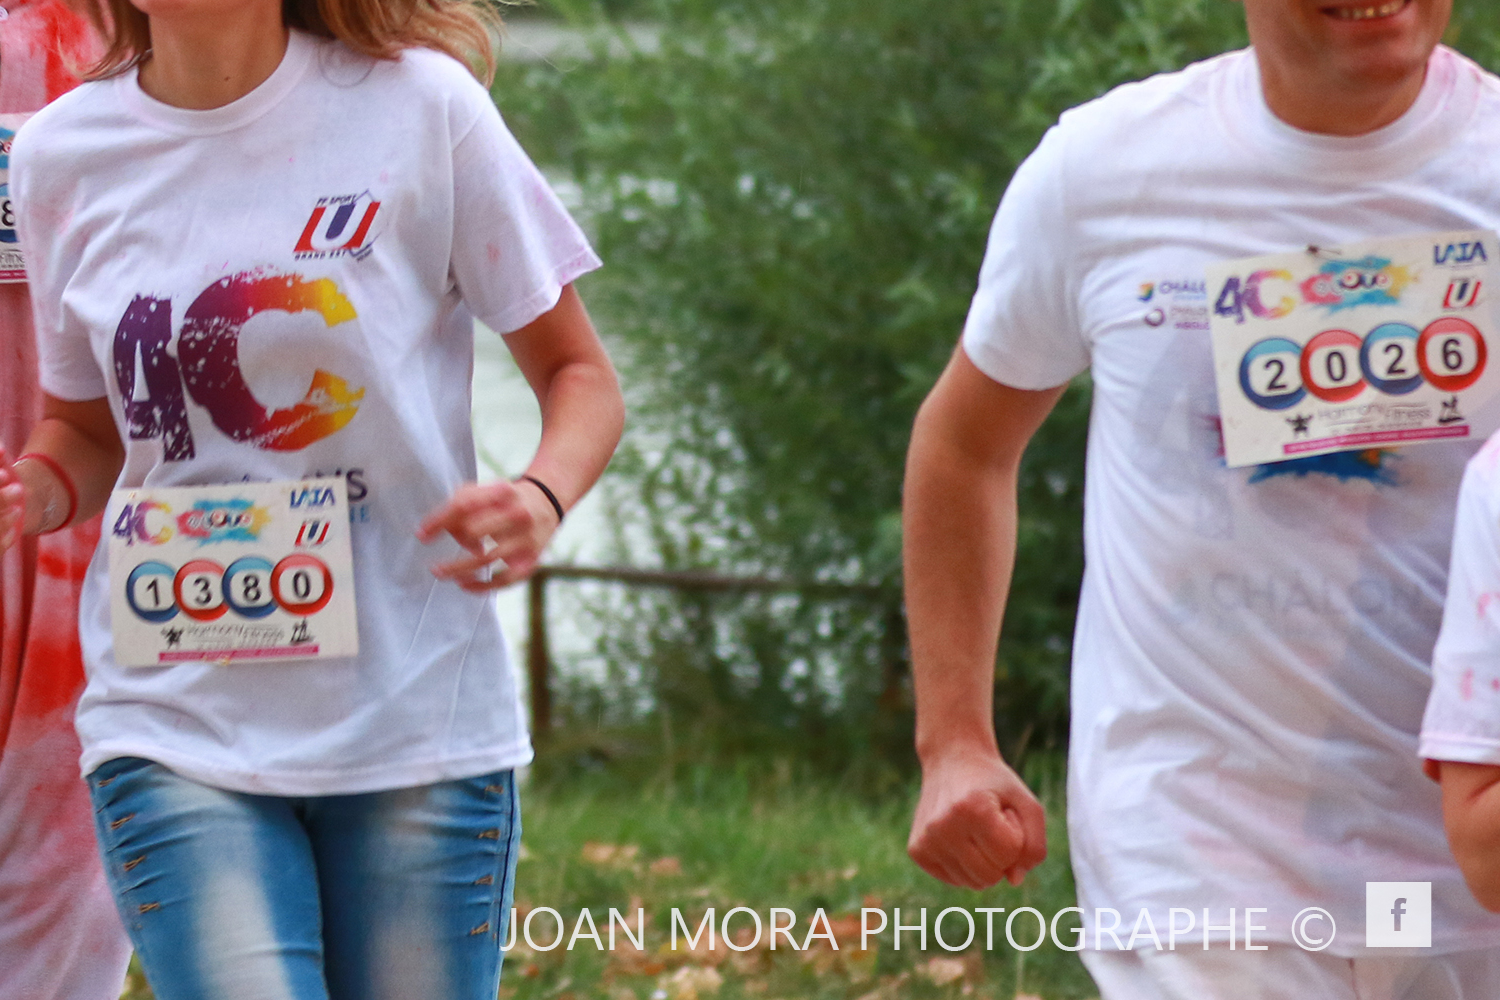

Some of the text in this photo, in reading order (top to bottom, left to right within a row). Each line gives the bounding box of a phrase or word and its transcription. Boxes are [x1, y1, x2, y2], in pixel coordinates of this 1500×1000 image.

[113, 265, 366, 463] 4C
[1263, 338, 1463, 392] 2026
[146, 570, 312, 607] 1380
